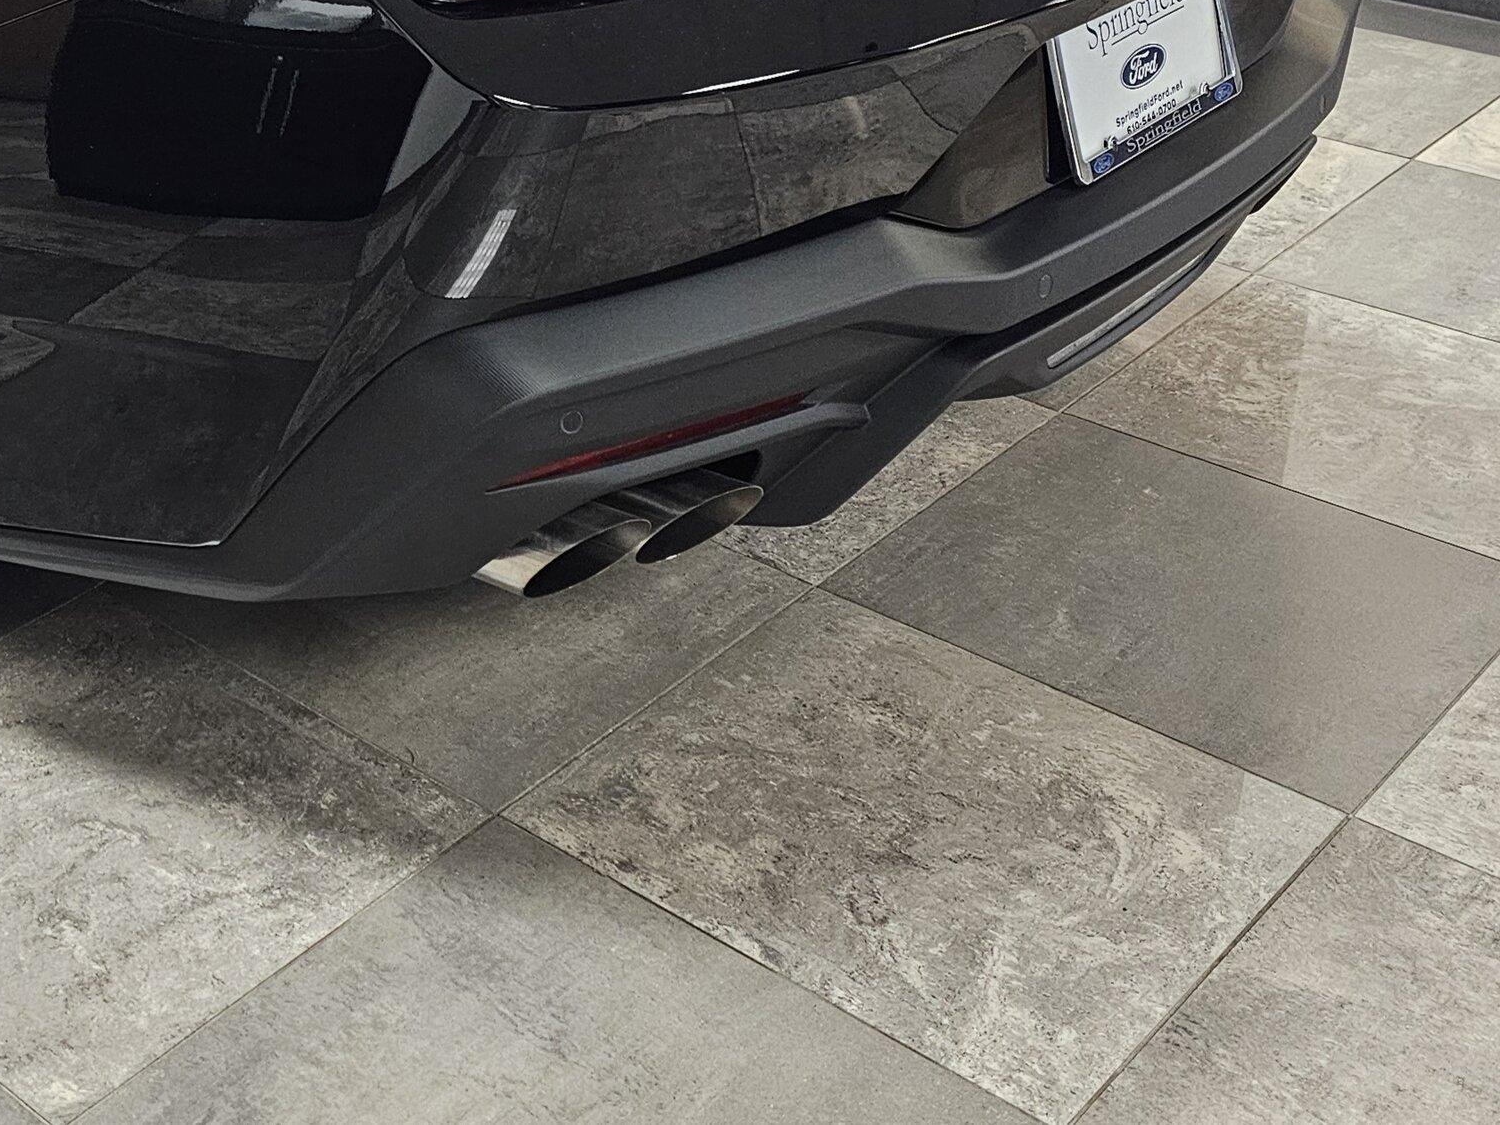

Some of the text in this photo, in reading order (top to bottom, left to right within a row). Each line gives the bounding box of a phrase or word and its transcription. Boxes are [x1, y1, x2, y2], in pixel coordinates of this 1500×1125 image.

[1129, 50, 1159, 86] Ford
[1115, 80, 1184, 128] SpringfieldFord.net
[1126, 98, 1203, 154] Springfield
